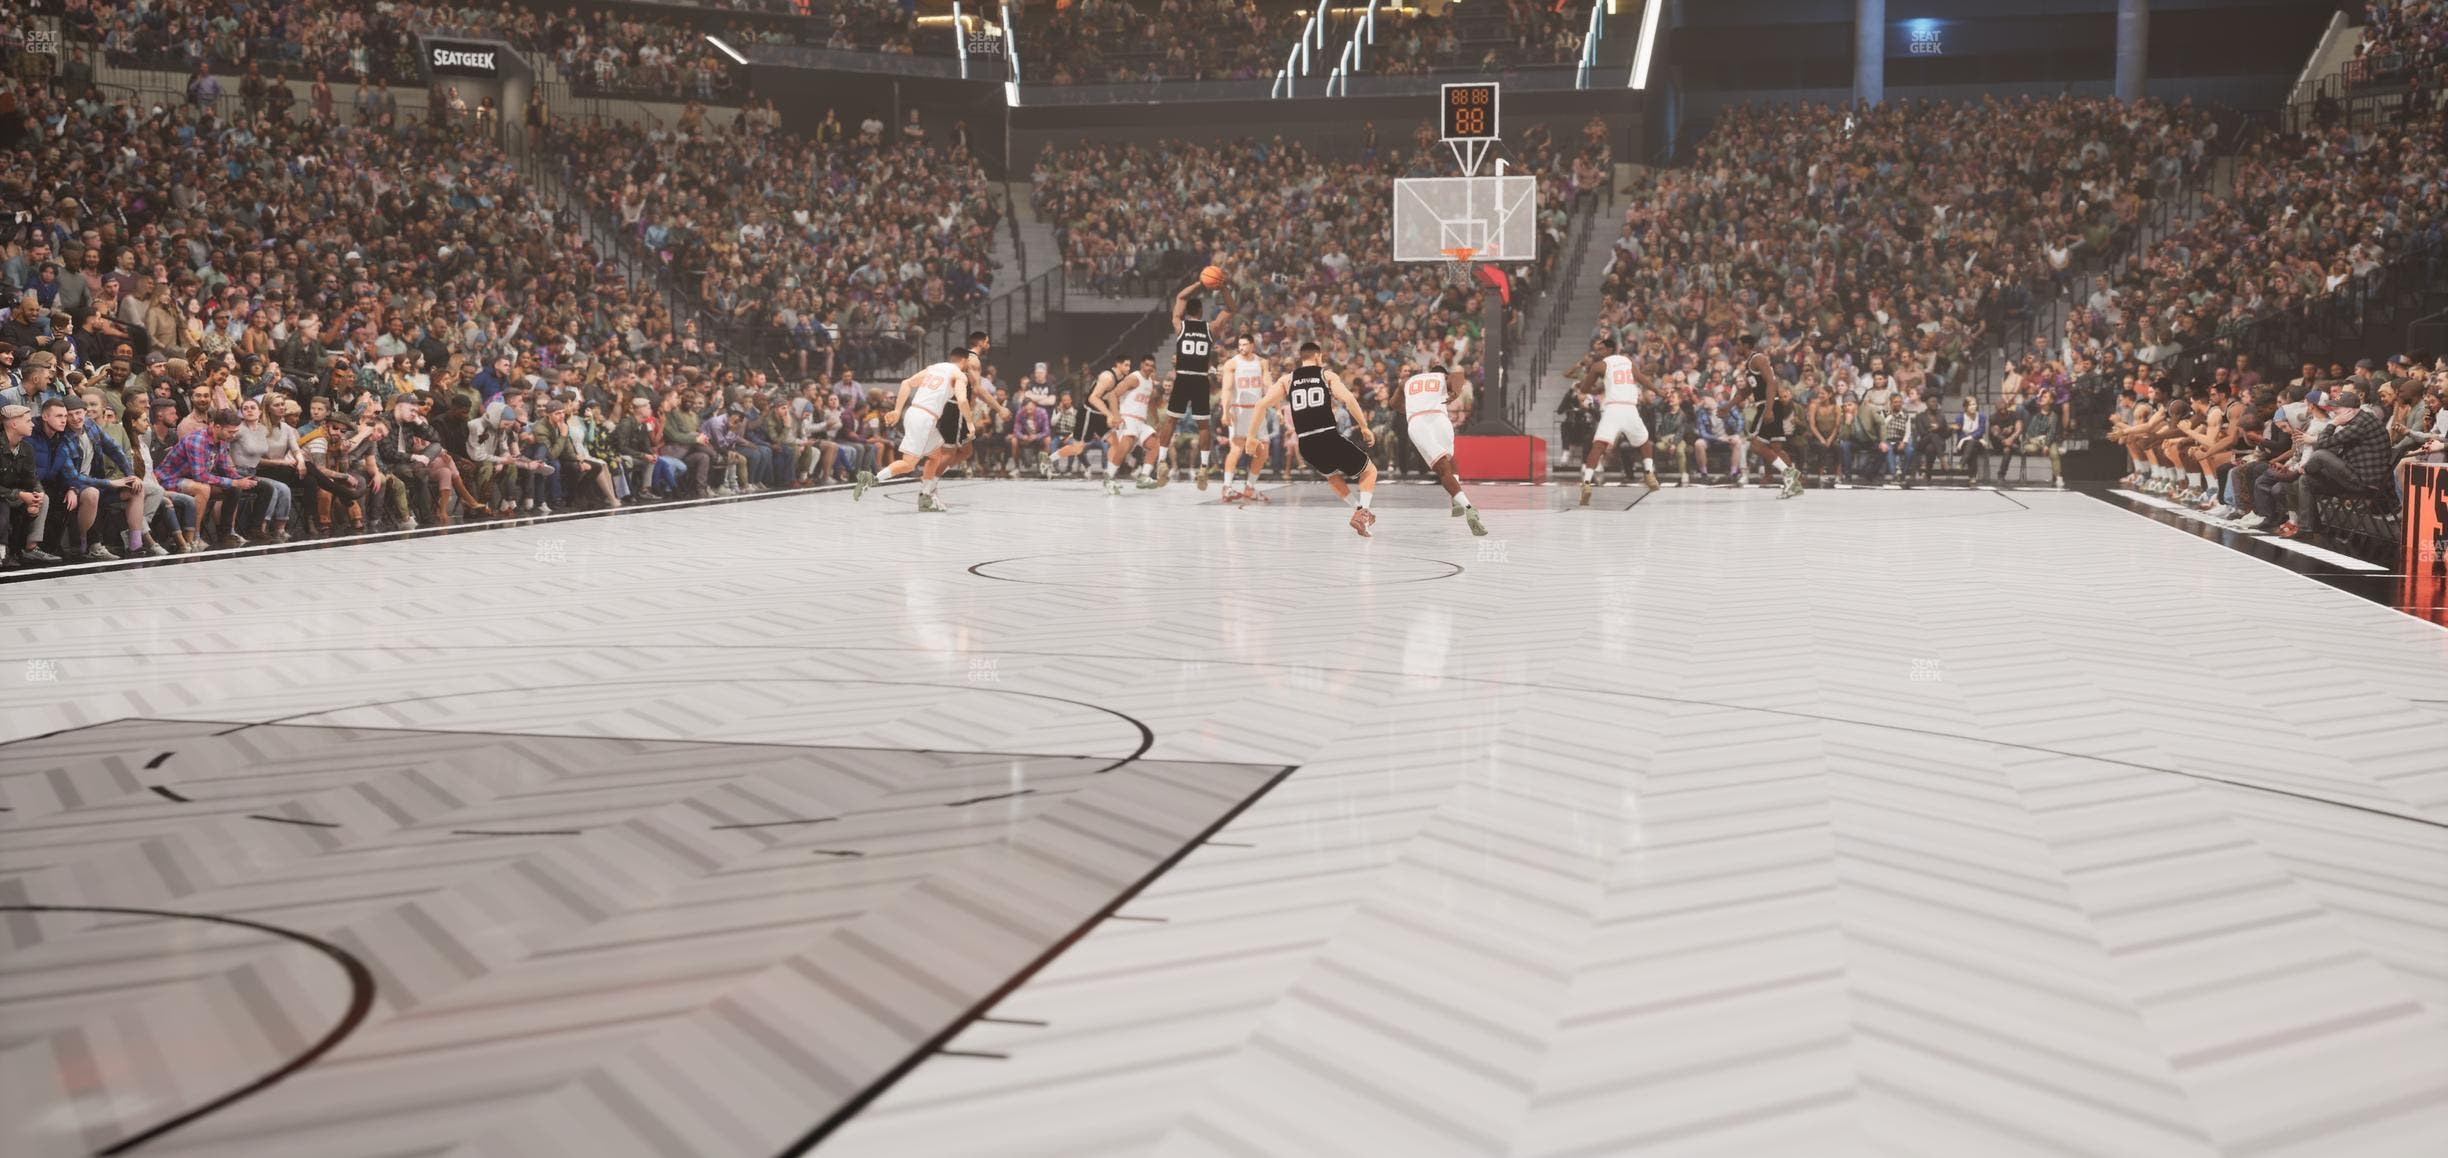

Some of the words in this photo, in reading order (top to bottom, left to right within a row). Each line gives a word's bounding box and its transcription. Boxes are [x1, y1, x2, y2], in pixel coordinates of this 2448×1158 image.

[433, 48, 496, 70] SEATGEEK
[1451, 88, 1468, 105] 88
[1472, 88, 1488, 105] 88
[1455, 107, 1484, 134] 88
[1181, 340, 1209, 356] 00
[1237, 376, 1261, 389] 00
[1409, 378, 1440, 396] 00
[1291, 386, 1325, 412] 00
